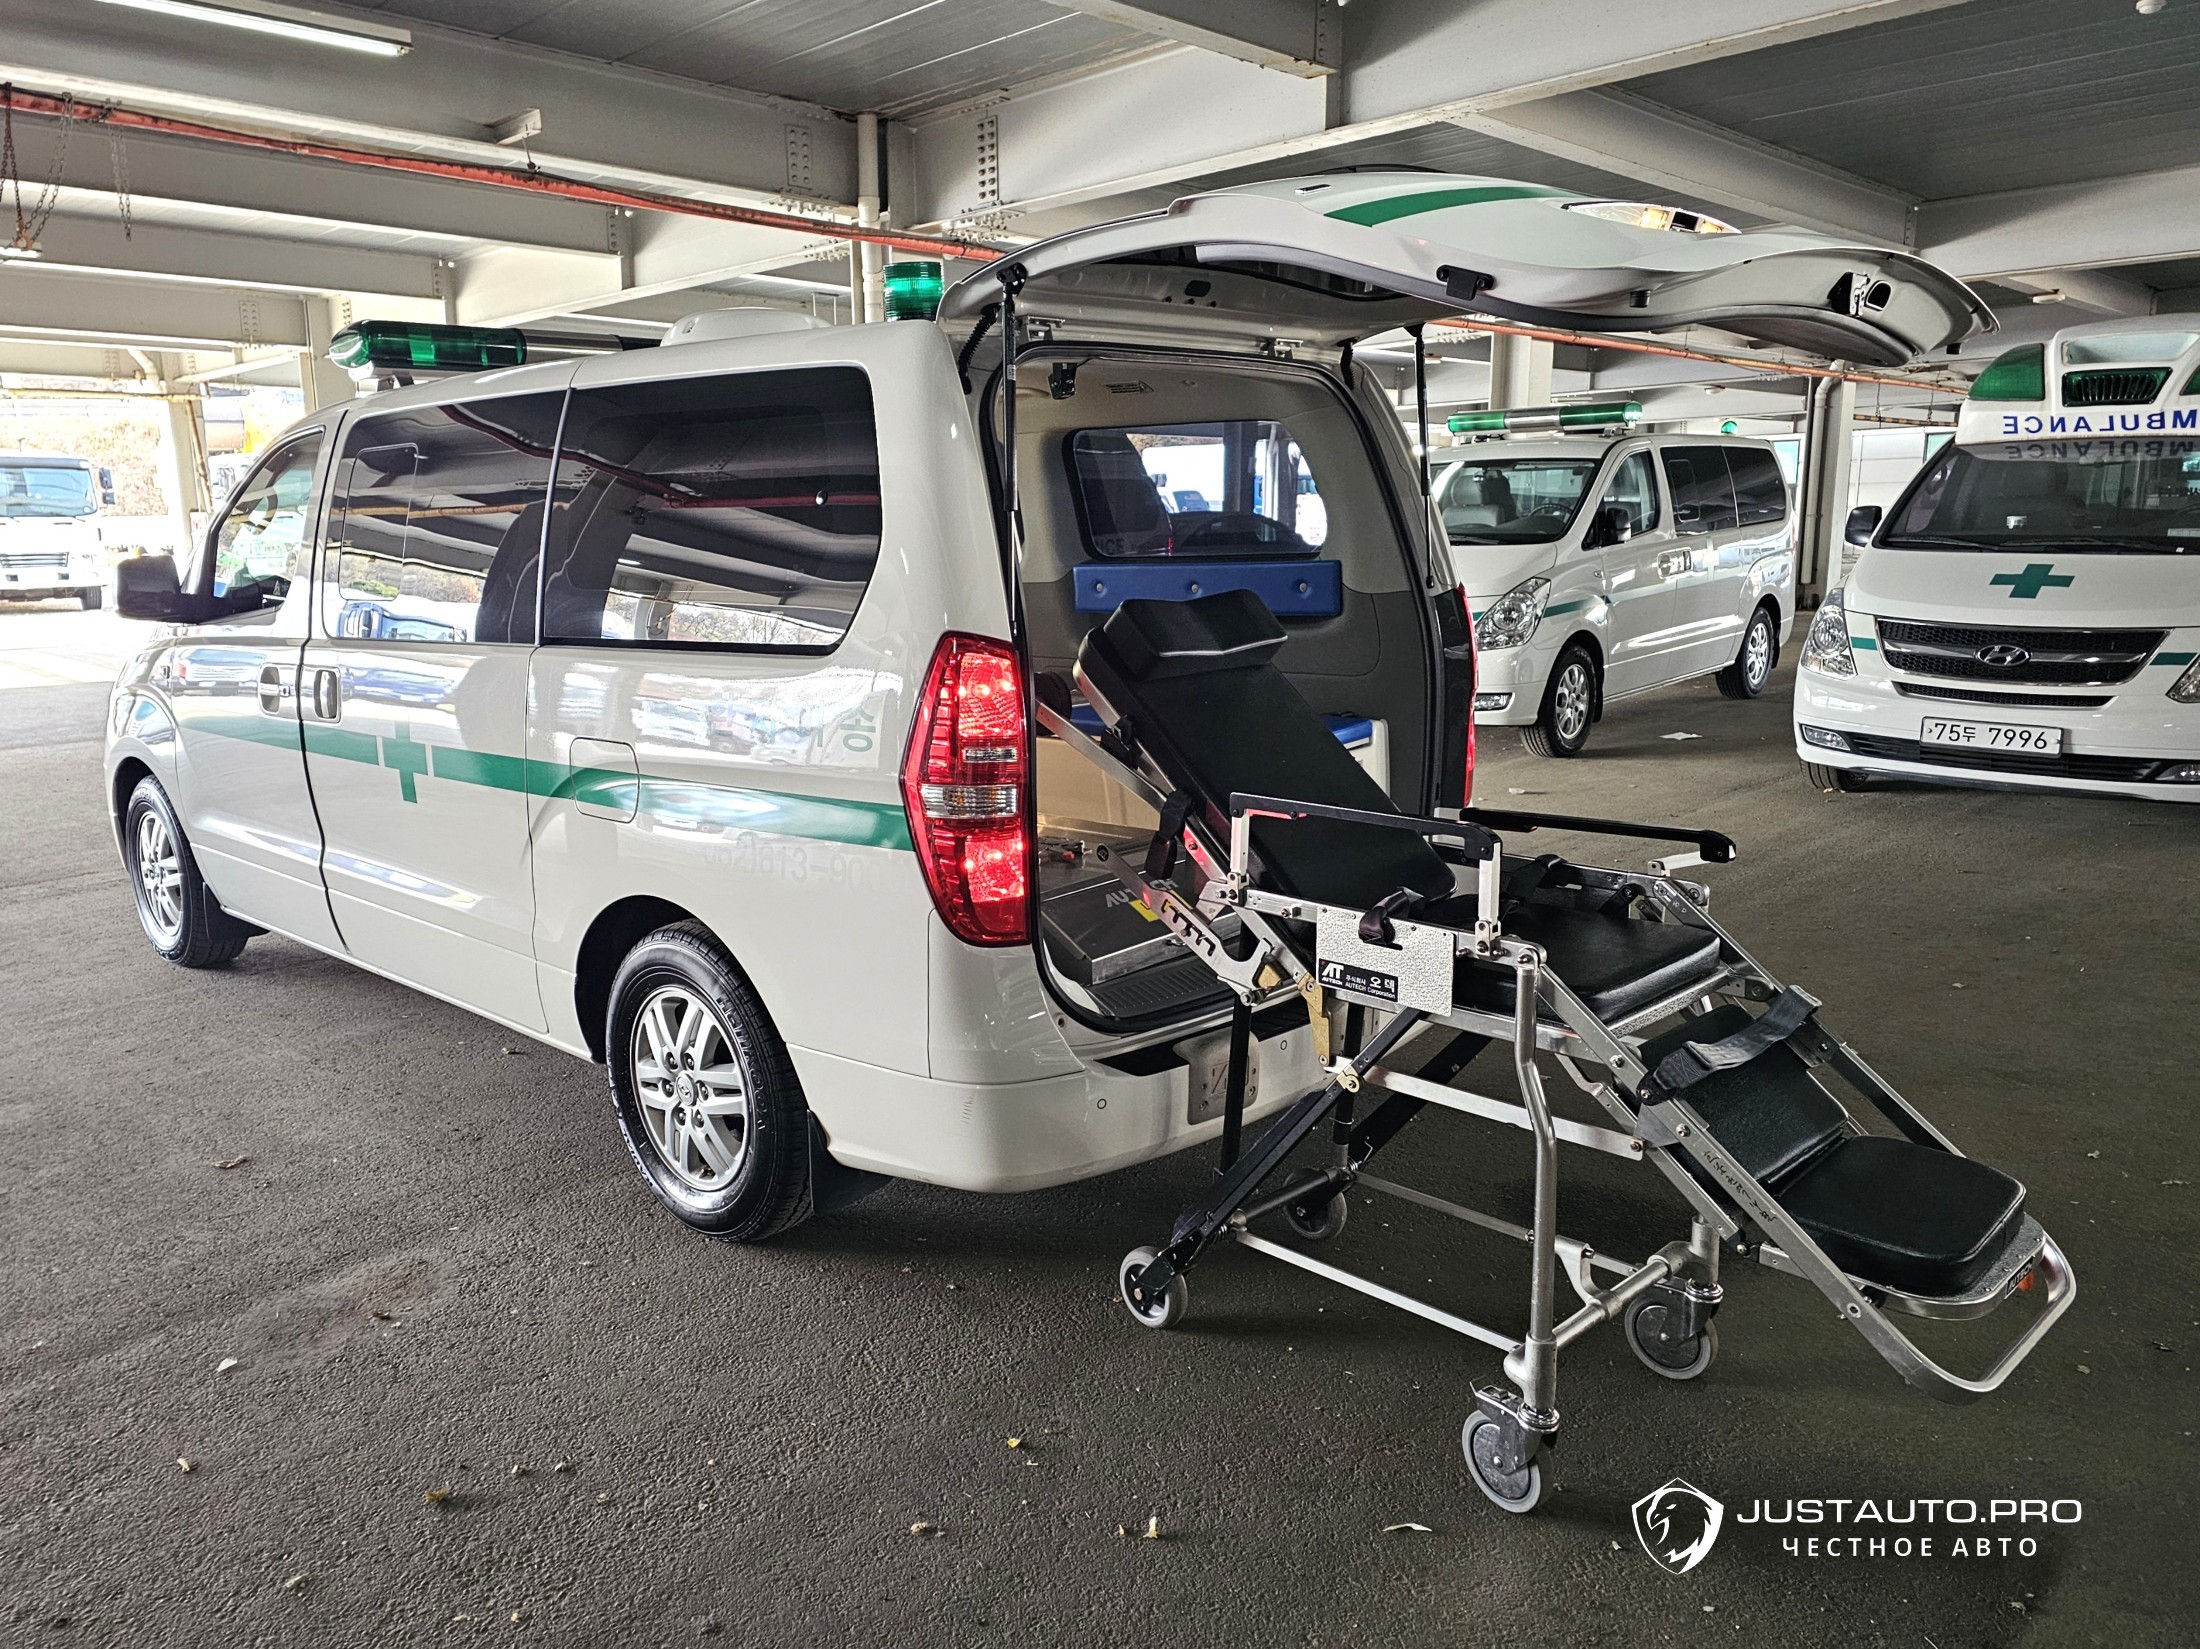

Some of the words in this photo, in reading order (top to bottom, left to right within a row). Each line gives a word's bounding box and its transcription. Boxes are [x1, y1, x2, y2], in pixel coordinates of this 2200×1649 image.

[1934, 722, 1976, 742] 75두
[1988, 727, 2047, 749] 7996
[1105, 879, 1178, 908] AUCH
